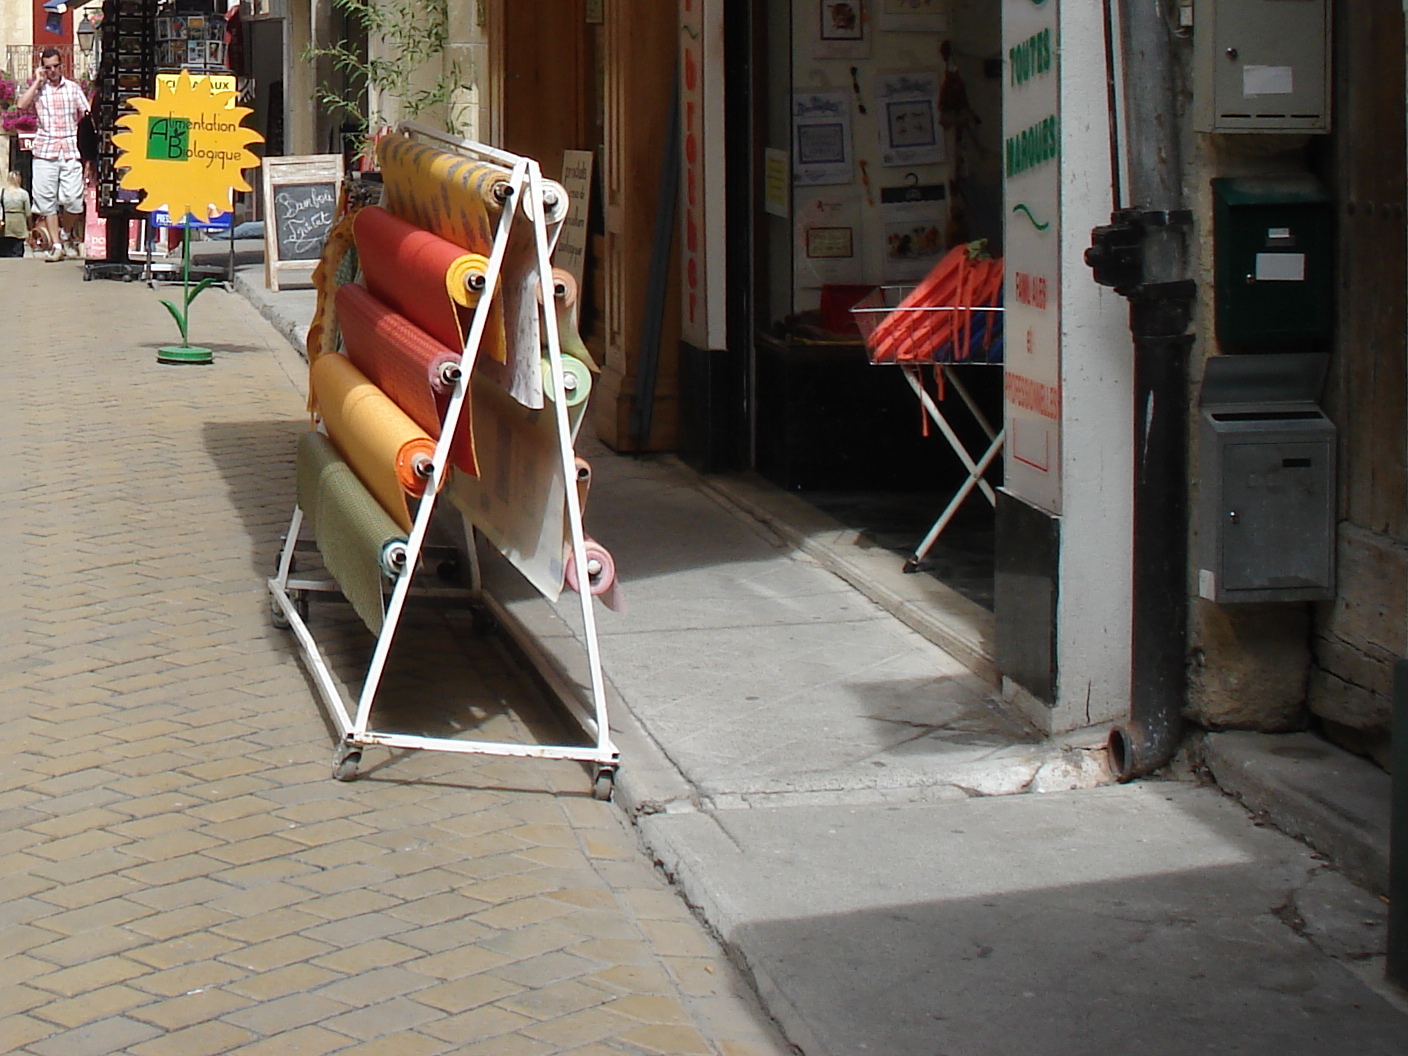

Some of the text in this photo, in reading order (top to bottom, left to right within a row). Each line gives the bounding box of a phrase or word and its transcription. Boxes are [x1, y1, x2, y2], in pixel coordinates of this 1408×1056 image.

[1009, 27, 1052, 87] TOUTES
[149, 111, 237, 142] Alimentation
[168, 135, 242, 170] Biologique
[1006, 114, 1057, 179] MARQUES
[685, 47, 697, 324] brother
